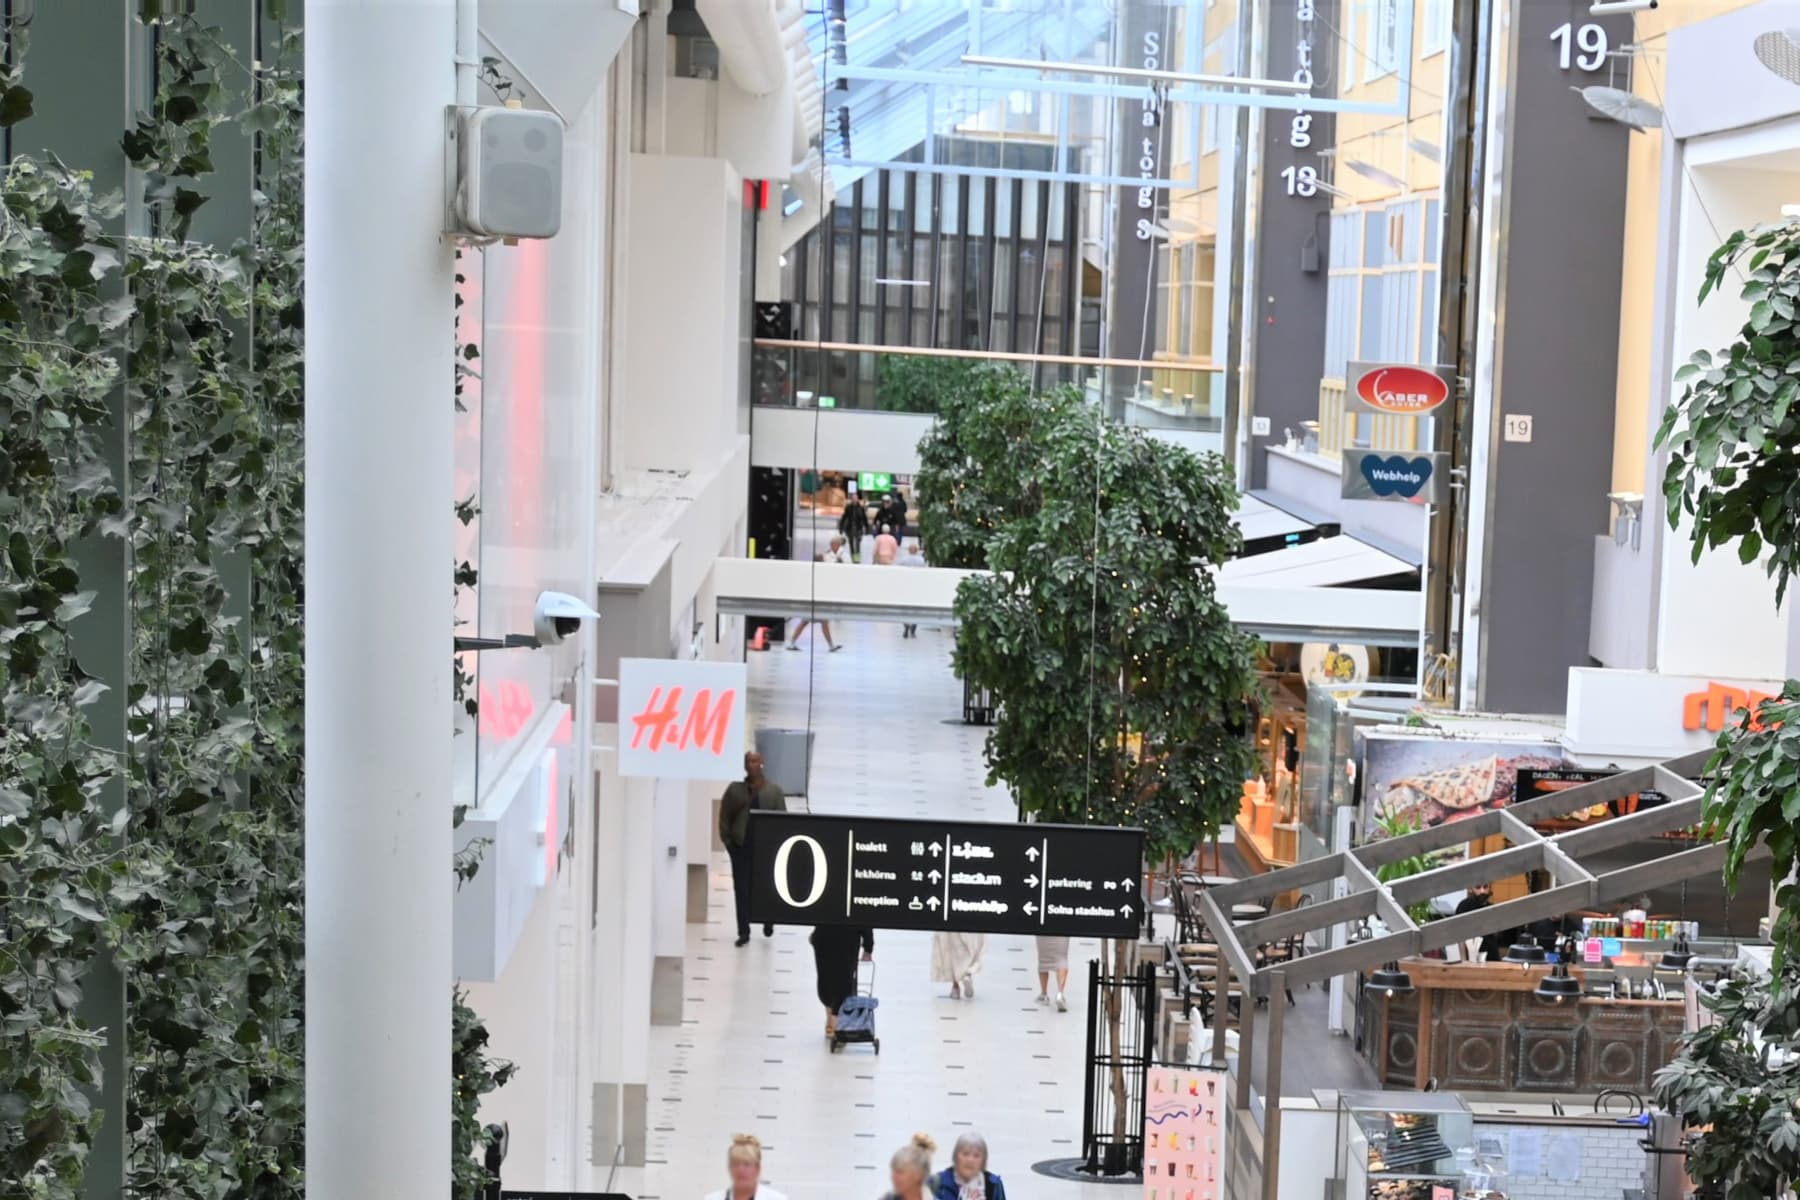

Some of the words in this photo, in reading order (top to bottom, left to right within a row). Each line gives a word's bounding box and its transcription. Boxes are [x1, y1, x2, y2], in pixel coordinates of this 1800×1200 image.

[1549, 22, 1608, 71] 19
[1508, 420, 1529, 436] 19
[1371, 469, 1421, 484] Webhelp
[631, 686, 736, 756] H&M
[855, 841, 888, 853] toalett
[773, 834, 829, 908] 0
[854, 869, 897, 880] lekhörna
[1048, 877, 1093, 891] parkering
[853, 896, 899, 907] reception
[1047, 904, 1074, 915] Solna
[1075, 906, 1116, 917] stadshus
